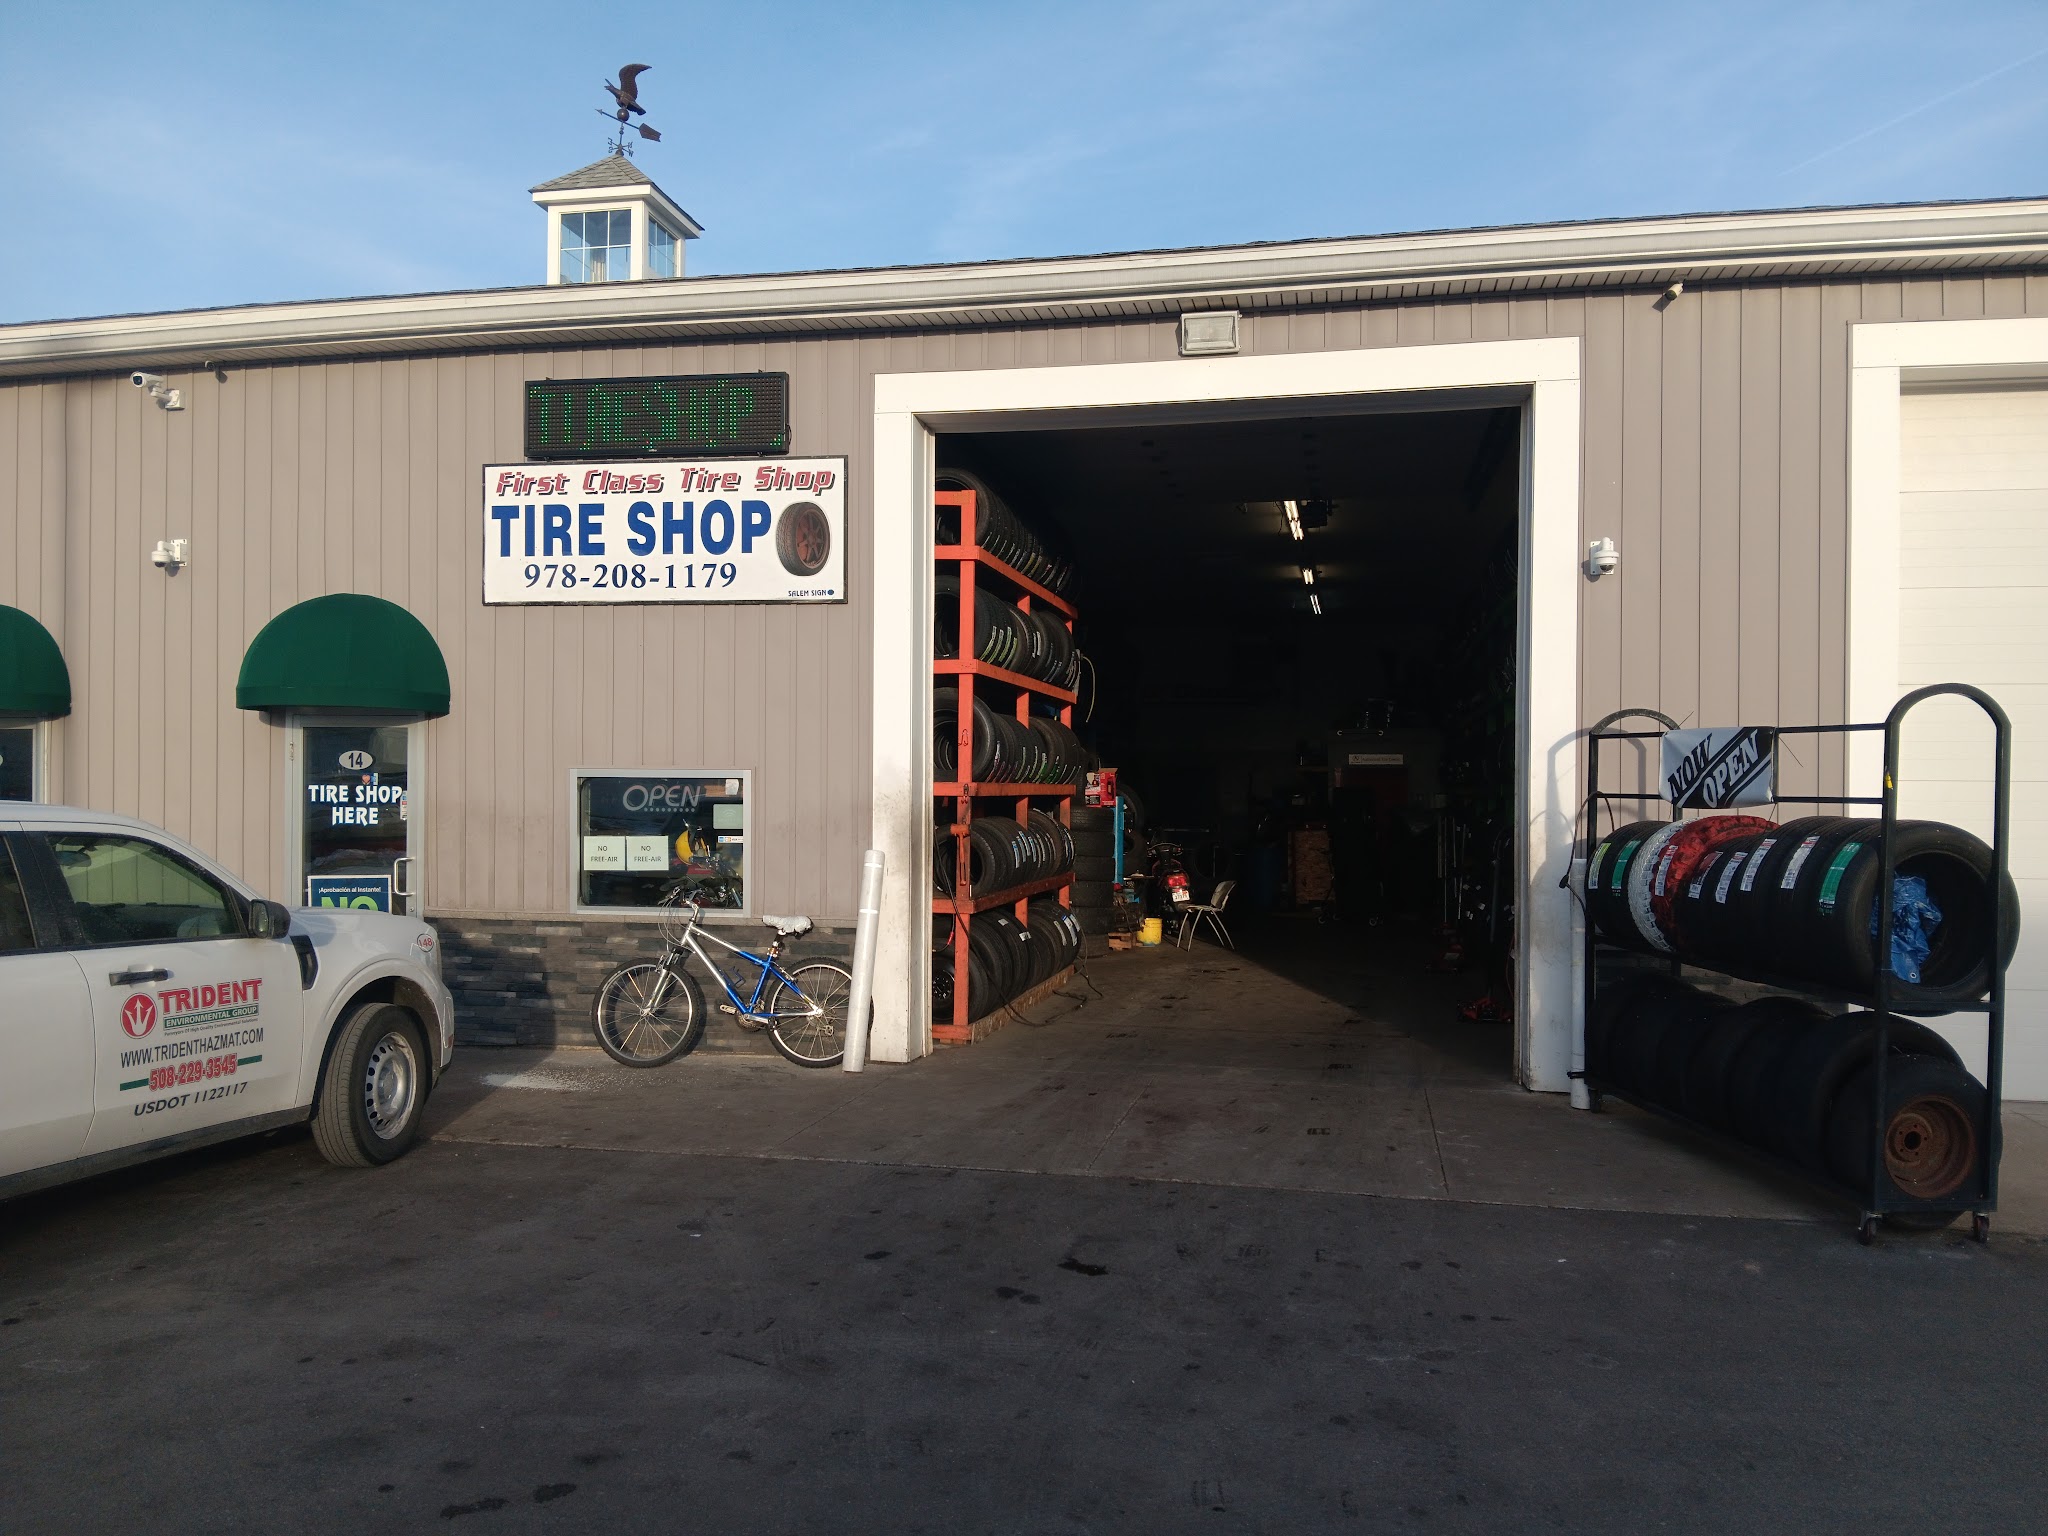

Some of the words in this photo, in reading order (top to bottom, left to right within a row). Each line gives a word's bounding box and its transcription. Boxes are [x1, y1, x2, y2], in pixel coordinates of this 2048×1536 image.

[496, 471, 571, 497] First
[582, 469, 665, 495] Class
[680, 467, 742, 493] Tire
[754, 465, 836, 496] Shop
[491, 502, 606, 557] TIRE
[627, 499, 772, 557] SHOP
[524, 562, 737, 589] 978-208-1179
[811, 589, 827, 597] SIGN
[348, 752, 364, 768] 14
[1667, 732, 1713, 799] NOW
[1702, 729, 1759, 808] OPEN
[308, 785, 349, 804] TIRE
[355, 785, 403, 804] SHOP
[622, 784, 701, 812] OPEN
[332, 806, 379, 826] HERE
[158, 978, 263, 1015] TRIDENT
[165, 1011, 231, 1027] ENVIRONMENTAL
[232, 1006, 257, 1017] GROUP
[120, 1027, 264, 1068] WWW.TRIDENTHAZMAT.COM
[134, 1093, 190, 1117] USDOT
[194, 1081, 248, 1104] 1122117
